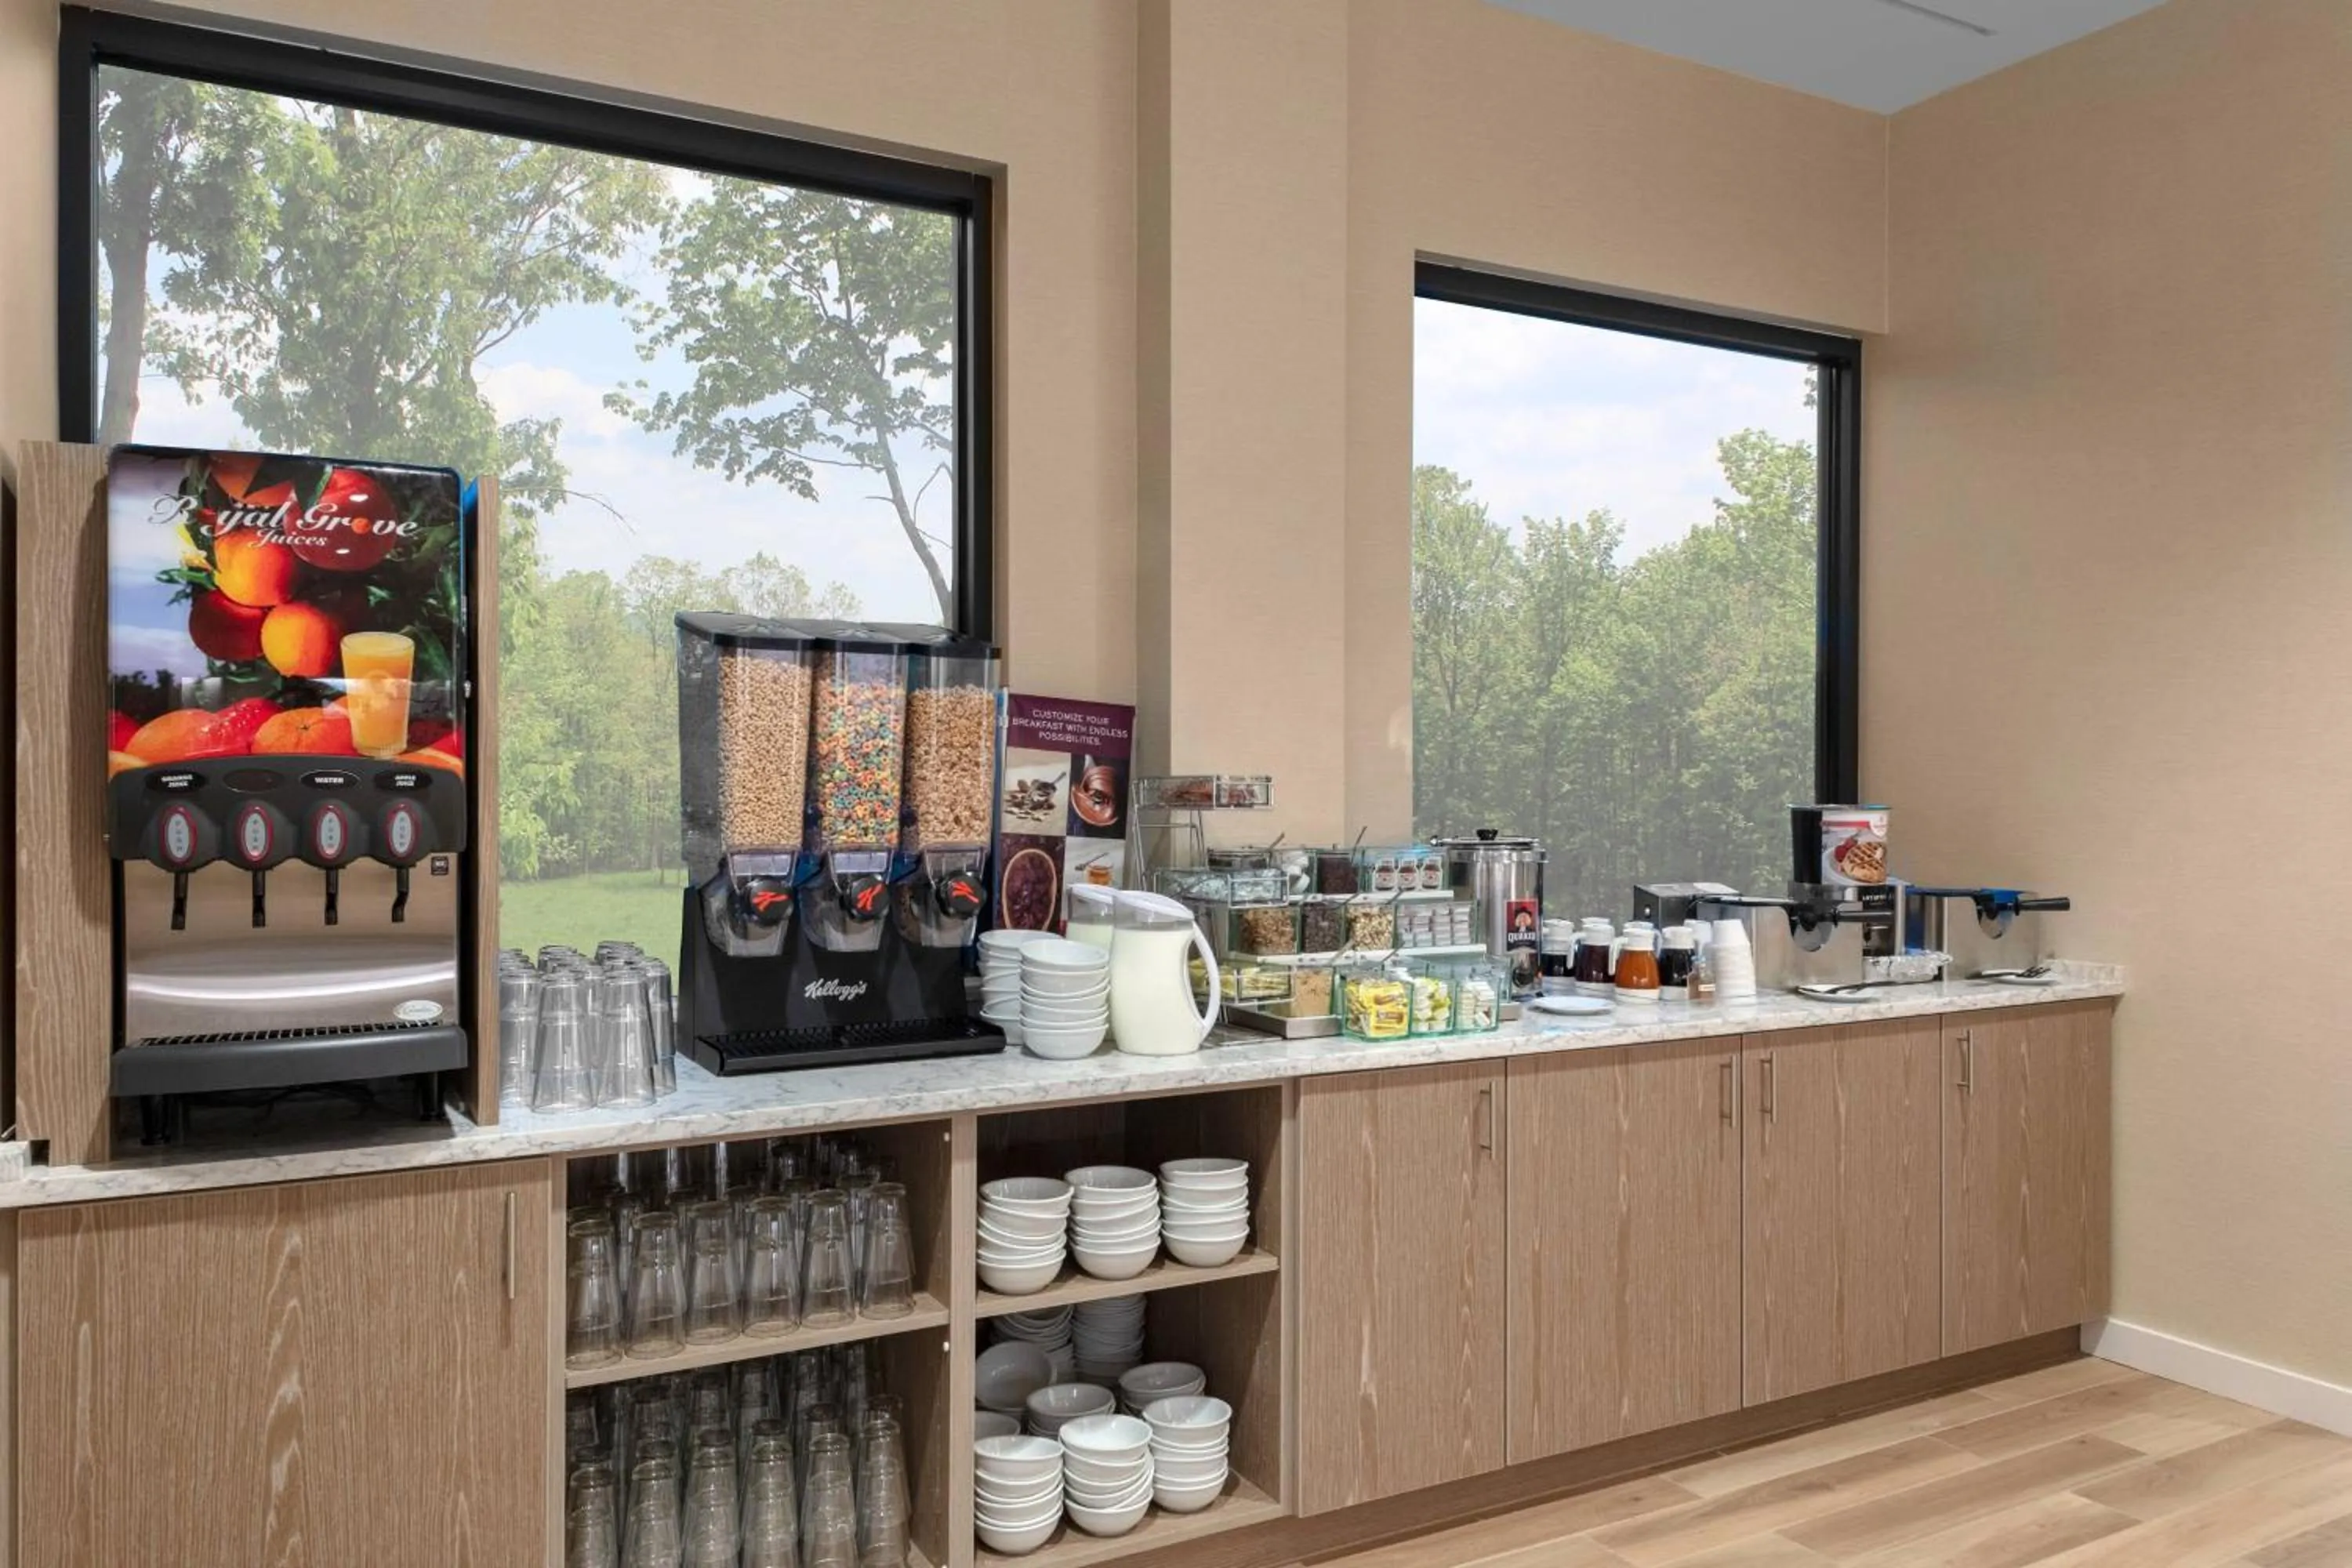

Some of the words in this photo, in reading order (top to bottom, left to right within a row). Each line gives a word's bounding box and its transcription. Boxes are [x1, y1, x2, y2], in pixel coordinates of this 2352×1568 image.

[296, 503, 419, 539] Grove
[247, 528, 328, 549] Juices
[1012, 717, 1064, 730] BREAKFAST
[1065, 723, 1087, 734] WITH
[1089, 725, 1128, 739] ENDLESS
[1032, 709, 1083, 722] CUSTOMIZE
[1086, 715, 1110, 725] YOUR
[804, 978, 867, 1001] Kellogg's
